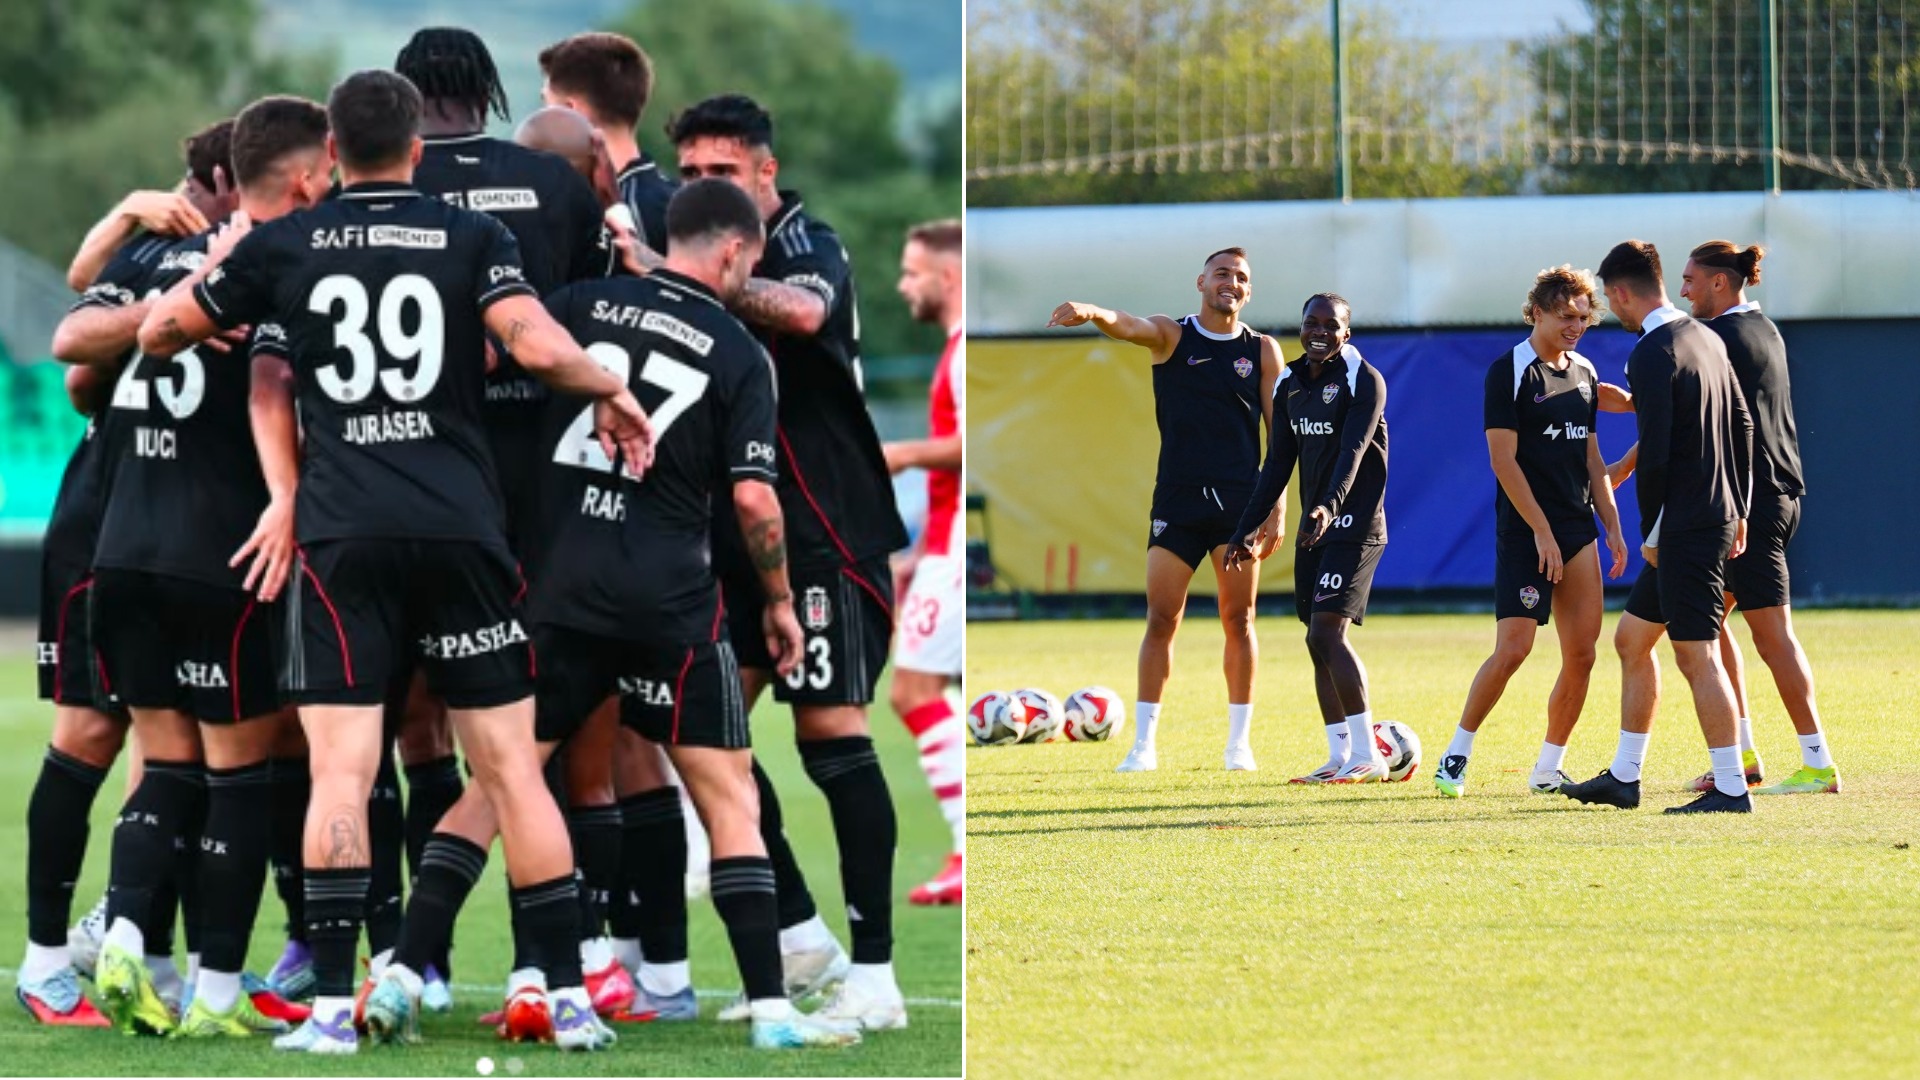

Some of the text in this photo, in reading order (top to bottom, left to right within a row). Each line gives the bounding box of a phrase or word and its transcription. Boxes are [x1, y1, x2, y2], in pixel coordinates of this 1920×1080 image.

[308, 273, 445, 403] 39
[552, 341, 710, 483] 27
[1299, 417, 1334, 436] ikas
[1334, 514, 1353, 529] 40
[1319, 572, 1343, 590] 40
[440, 619, 529, 659] PASHA
